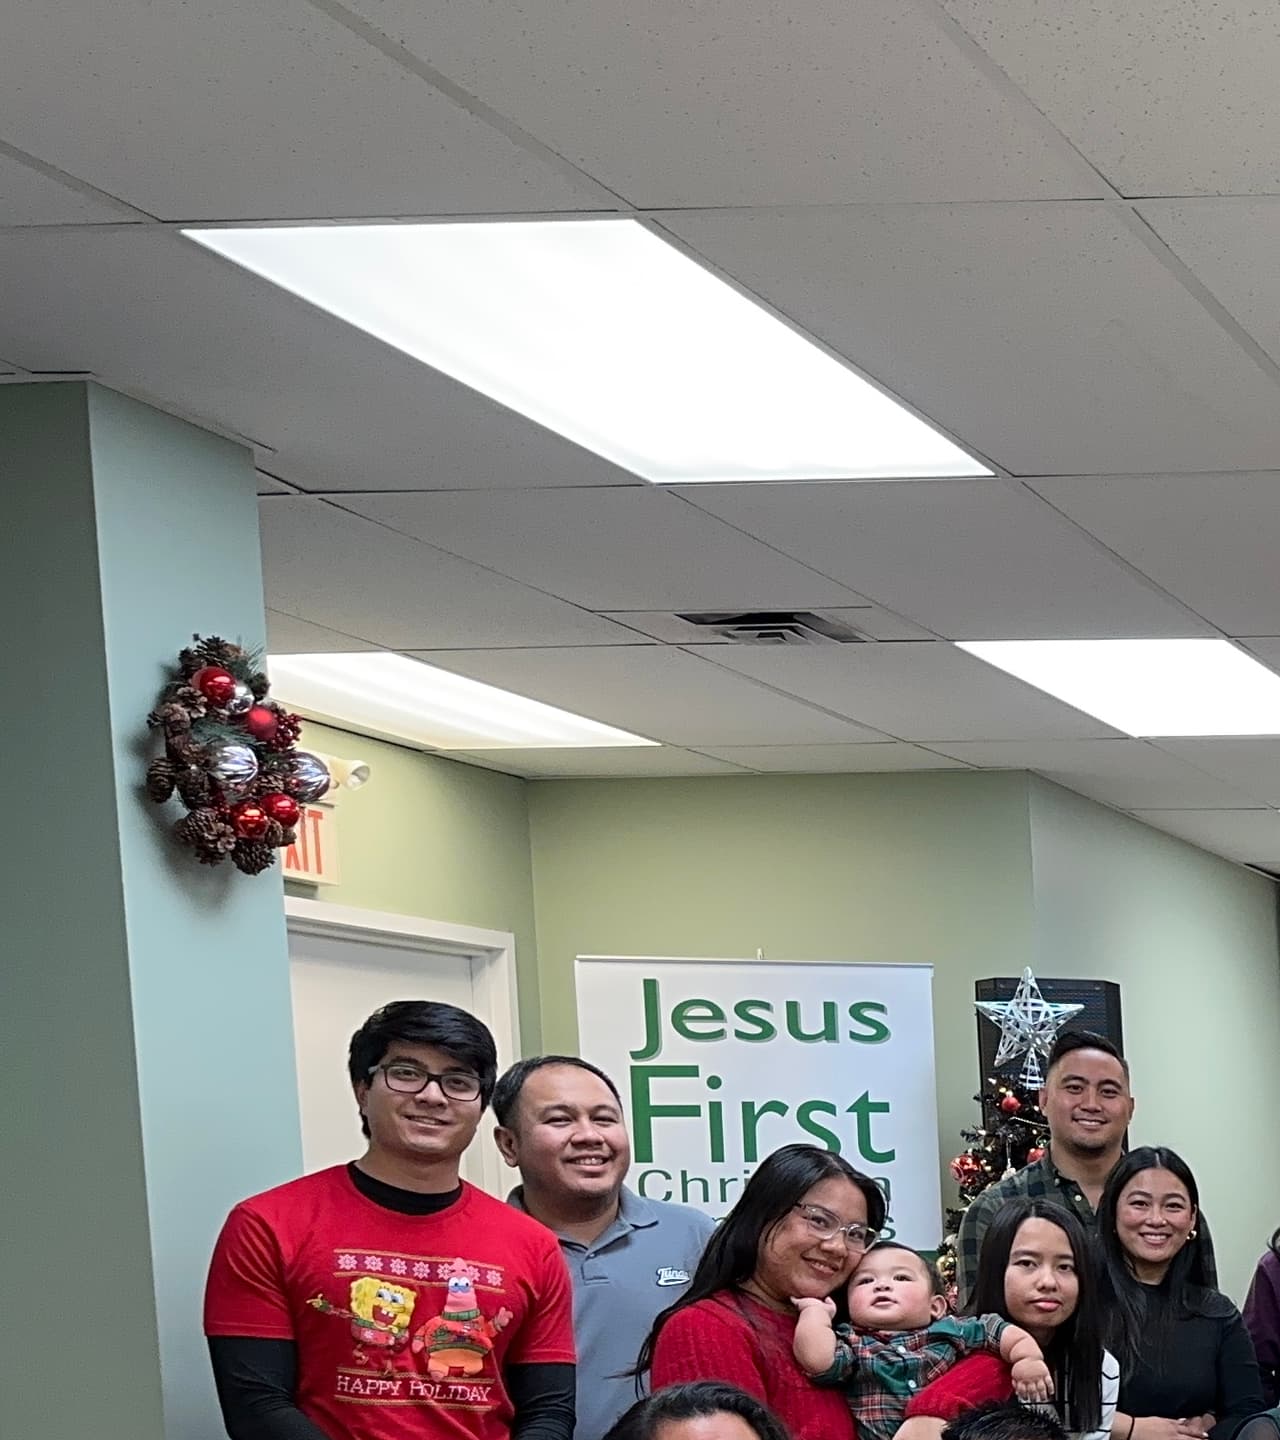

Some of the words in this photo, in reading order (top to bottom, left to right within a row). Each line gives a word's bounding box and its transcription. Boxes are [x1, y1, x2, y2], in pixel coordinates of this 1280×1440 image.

[629, 978, 891, 1061] Jesus
[630, 1065, 895, 1163] First
[337, 1376, 402, 1396] HAPPY
[409, 1380, 492, 1402] HOLIDAY
